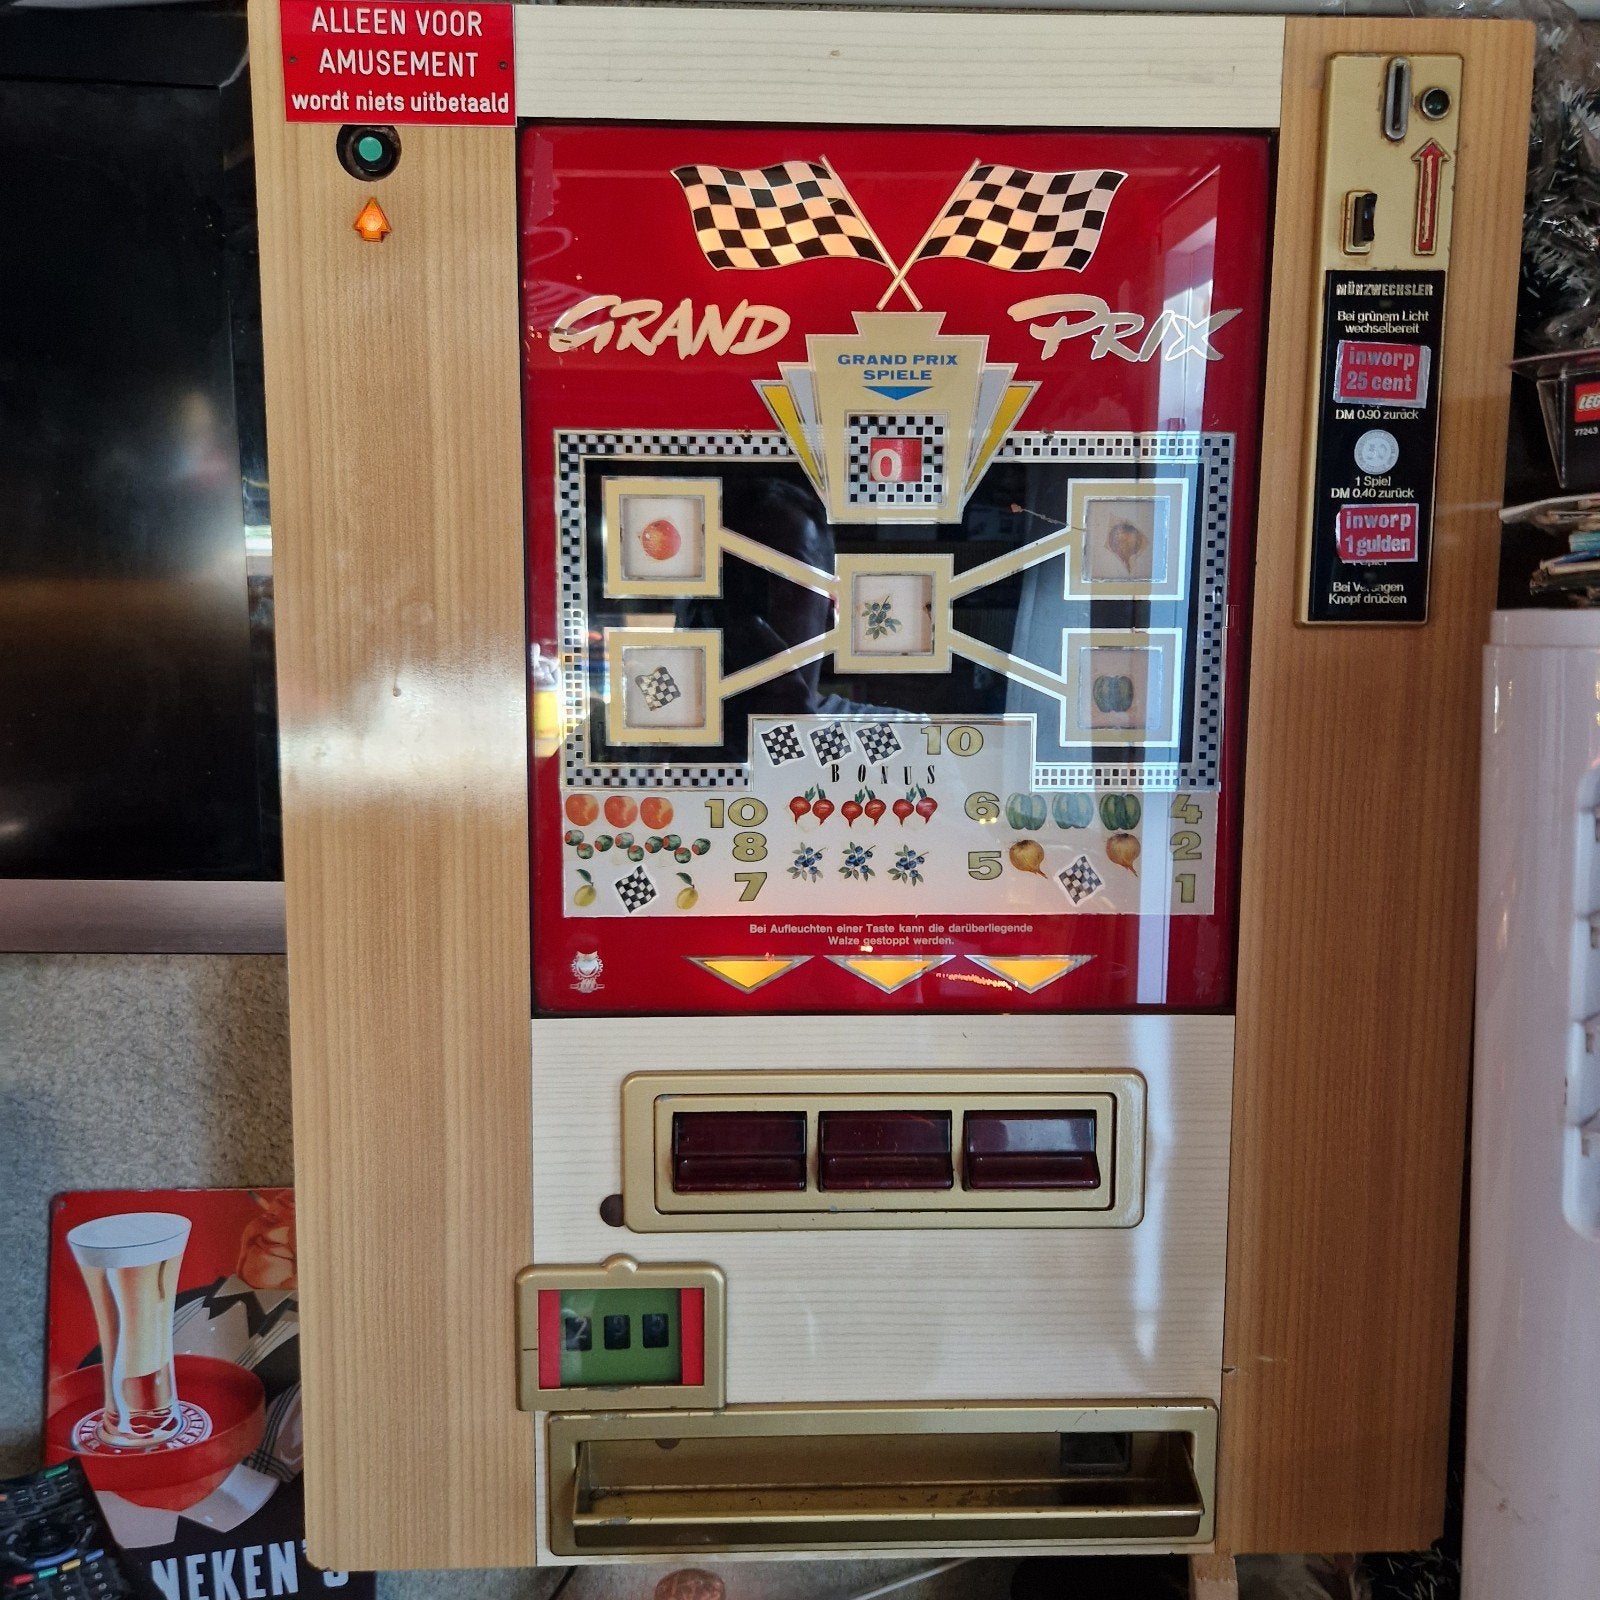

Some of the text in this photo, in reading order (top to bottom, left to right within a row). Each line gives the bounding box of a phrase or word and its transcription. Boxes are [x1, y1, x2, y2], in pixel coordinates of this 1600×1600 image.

[311, 7, 483, 37] ALLEEN VOOR
[319, 48, 479, 77] AMUSEMENT
[292, 90, 509, 113] wordt niets uitbetaald
[1336, 282, 1433, 297] MÜNZWECHSLER
[549, 293, 1243, 362] GRAND PRIX
[1337, 310, 1429, 324] Bei grünem Licht
[1345, 322, 1419, 334] wechselbereit
[837, 354, 958, 365] GRAND PRIX
[1349, 347, 1415, 367] inworp
[863, 370, 932, 380] SPIELE
[1346, 371, 1412, 392] 25 cent
[1335, 409, 1355, 420] DM
[1383, 408, 1419, 420] zurück
[1331, 488, 1351, 499] DM
[1378, 487, 1414, 499] zurück
[1355, 476, 1391, 489] 1 Spiel
[1346, 511, 1411, 531] inworp
[1345, 534, 1411, 557] 1 gulden
[1333, 582, 1350, 593] Bei
[1329, 593, 1407, 606] Knopf drücken
[921, 725, 984, 757] 10
[831, 764, 935, 785] BONUS
[704, 797, 768, 828] 10
[964, 791, 1000, 822] 6
[1171, 794, 1203, 824] 4
[732, 831, 768, 862] 8
[1170, 831, 1202, 861] 2
[967, 850, 1003, 880] 5
[734, 871, 767, 902] 7
[1175, 873, 1196, 903] 1
[749, 923, 1034, 936] Bei Aufleuchten einer Taste kann die darüberliegende
[828, 936, 955, 948] Walze gestoppt werden.
